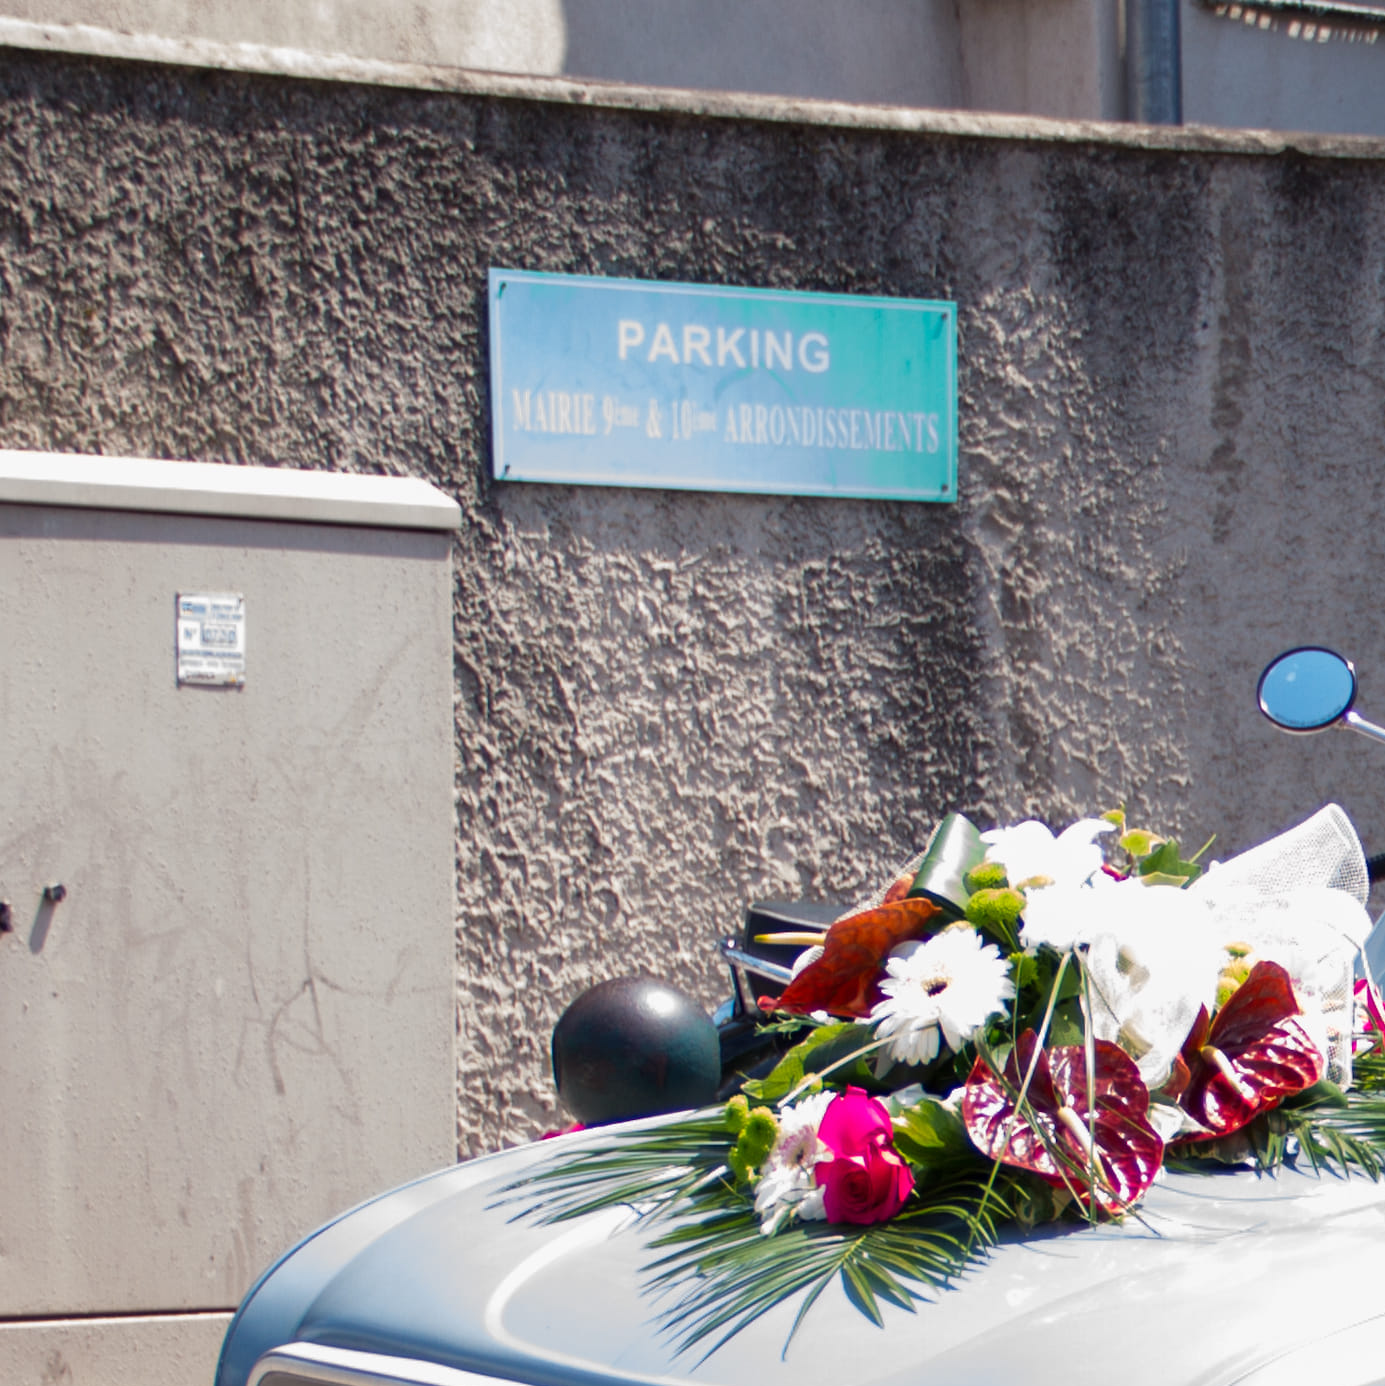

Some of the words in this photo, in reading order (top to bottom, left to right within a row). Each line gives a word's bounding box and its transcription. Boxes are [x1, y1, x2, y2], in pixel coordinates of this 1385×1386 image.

[618, 320, 831, 373] PARKING
[512, 388, 596, 436] MAIRIE
[646, 397, 663, 440] &
[724, 402, 940, 455] ARRONDISSEMENTS
